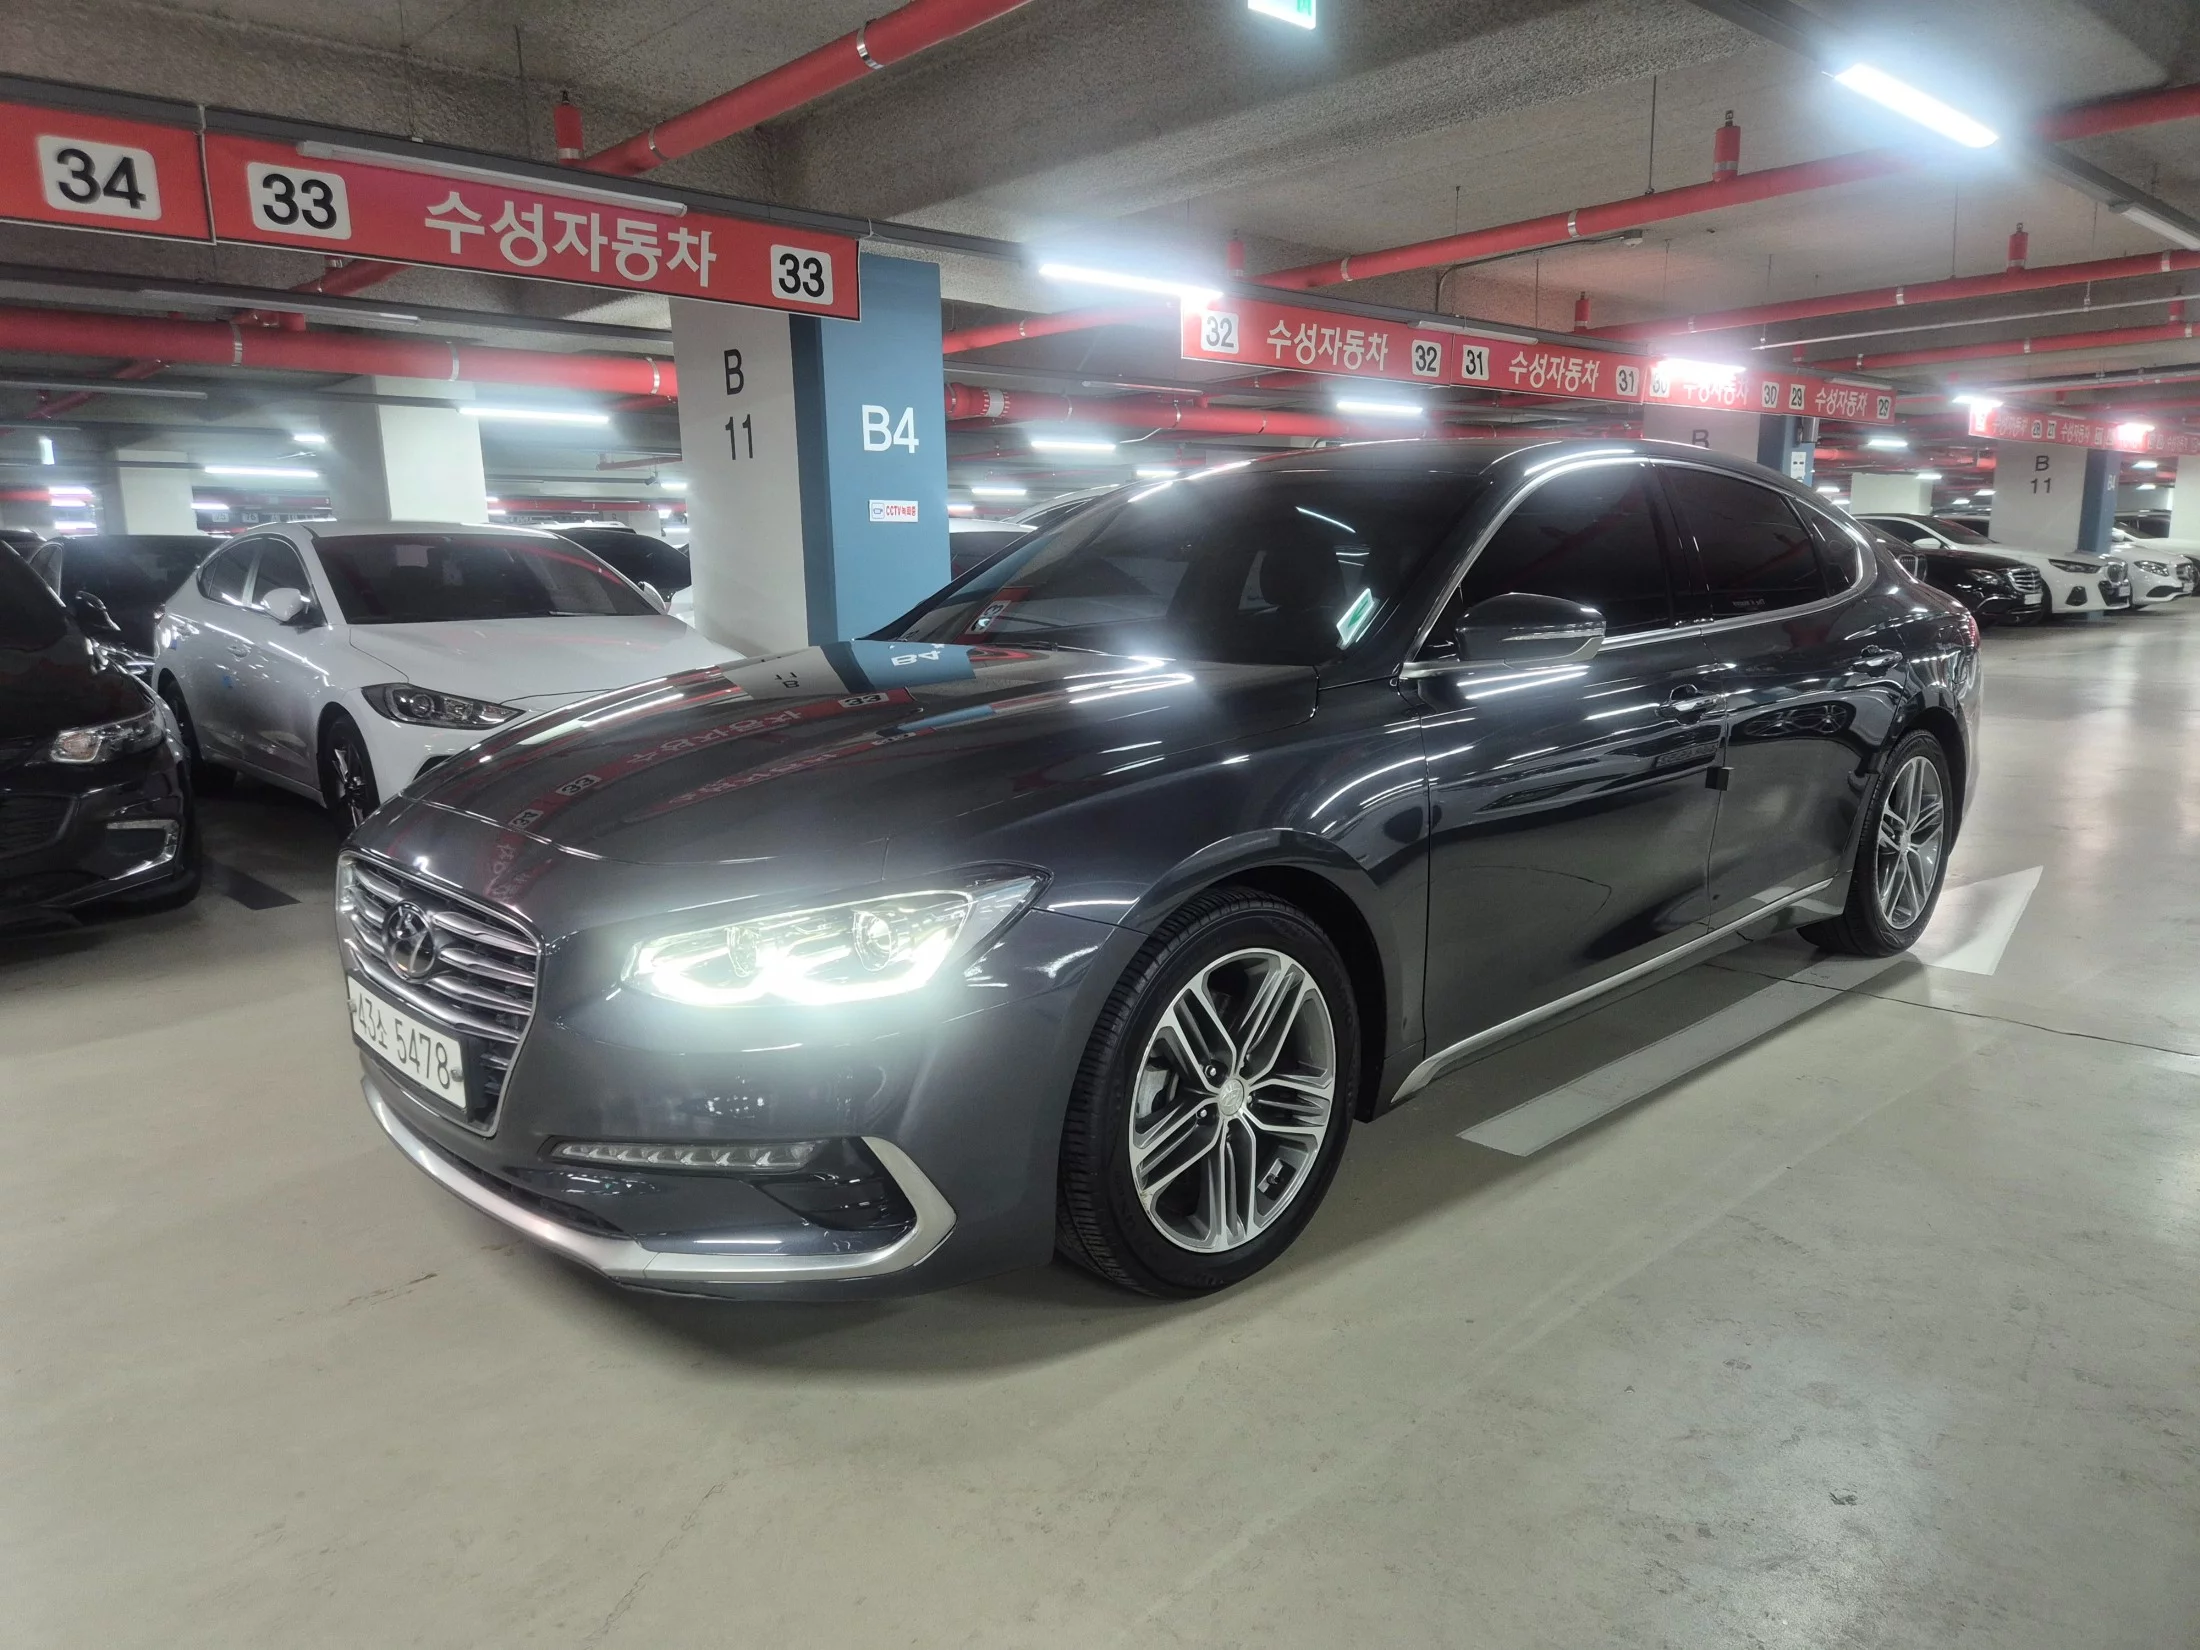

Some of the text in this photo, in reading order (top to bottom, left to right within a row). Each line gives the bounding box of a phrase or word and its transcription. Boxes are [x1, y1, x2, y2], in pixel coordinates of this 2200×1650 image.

[56, 148, 147, 209] 34
[262, 173, 825, 298] 33 수성자동차 33
[1205, 315, 1437, 373] 32 수성자동차 32
[724, 349, 744, 395] B
[1465, 348, 1635, 392] 31 수성자동차 31
[1764, 385, 1777, 405] 30
[1791, 386, 1889, 417] 29 수성자동차 29
[725, 414, 753, 460] 11
[862, 404, 919, 454] B4
[2030, 478, 2052, 494] 11
[2035, 455, 2050, 471] B
[358, 992, 450, 1090] 43소 5478
